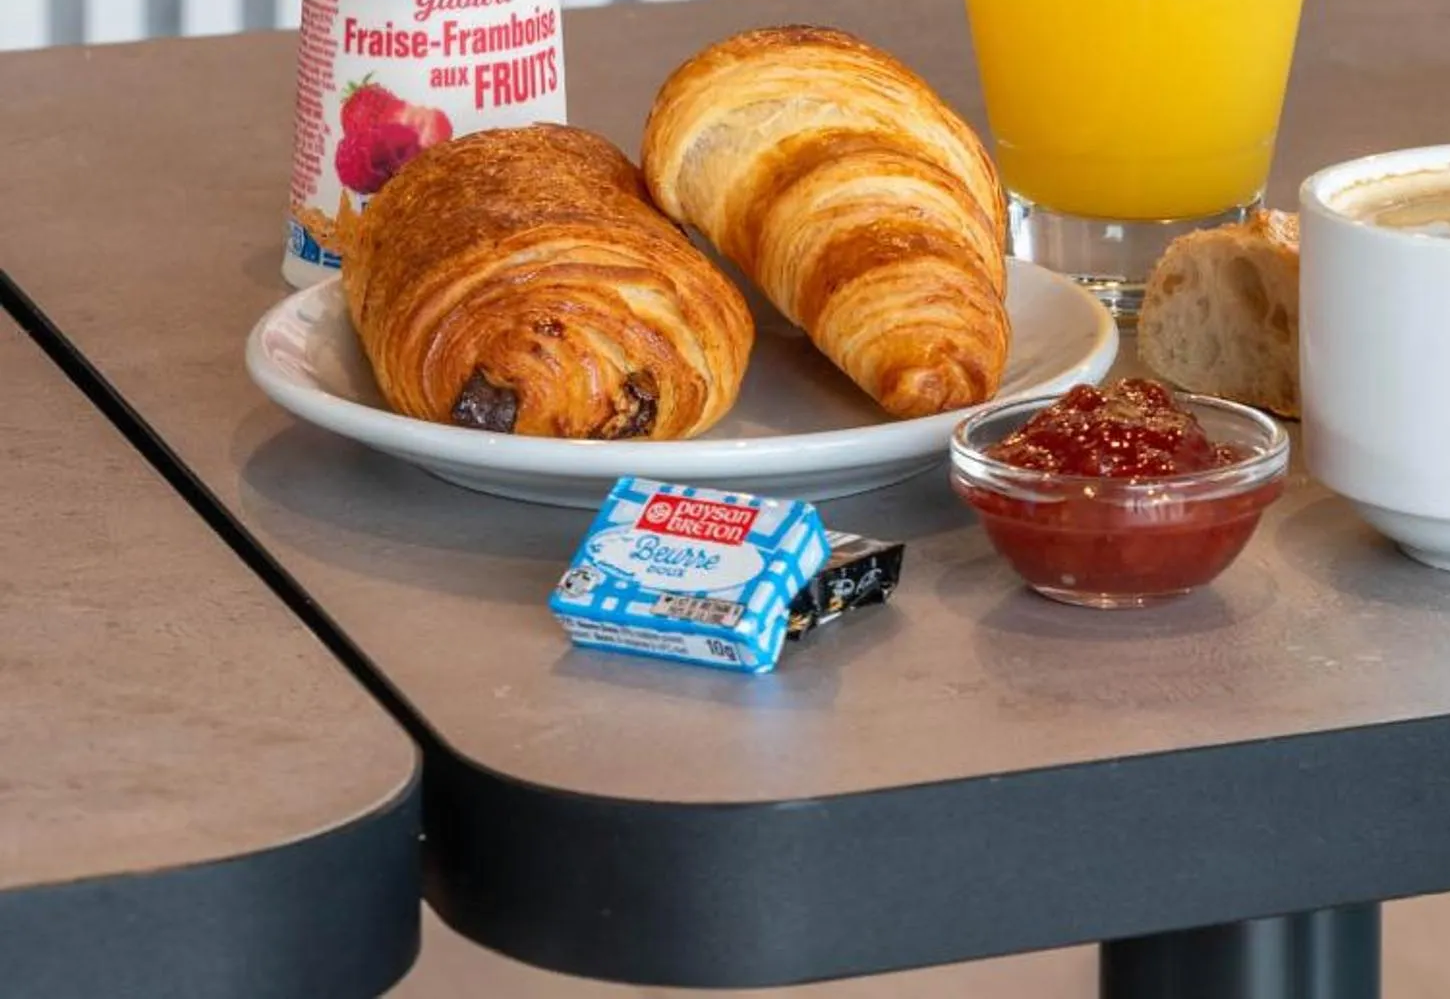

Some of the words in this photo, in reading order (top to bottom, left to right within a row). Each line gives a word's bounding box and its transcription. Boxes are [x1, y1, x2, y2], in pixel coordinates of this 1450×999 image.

[344, 7, 556, 58] Fraise-Framboise
[430, 64, 470, 88] aux
[475, 46, 558, 110] FRUITS
[630, 534, 721, 571] Beurre
[706, 638, 737, 661] 10g
